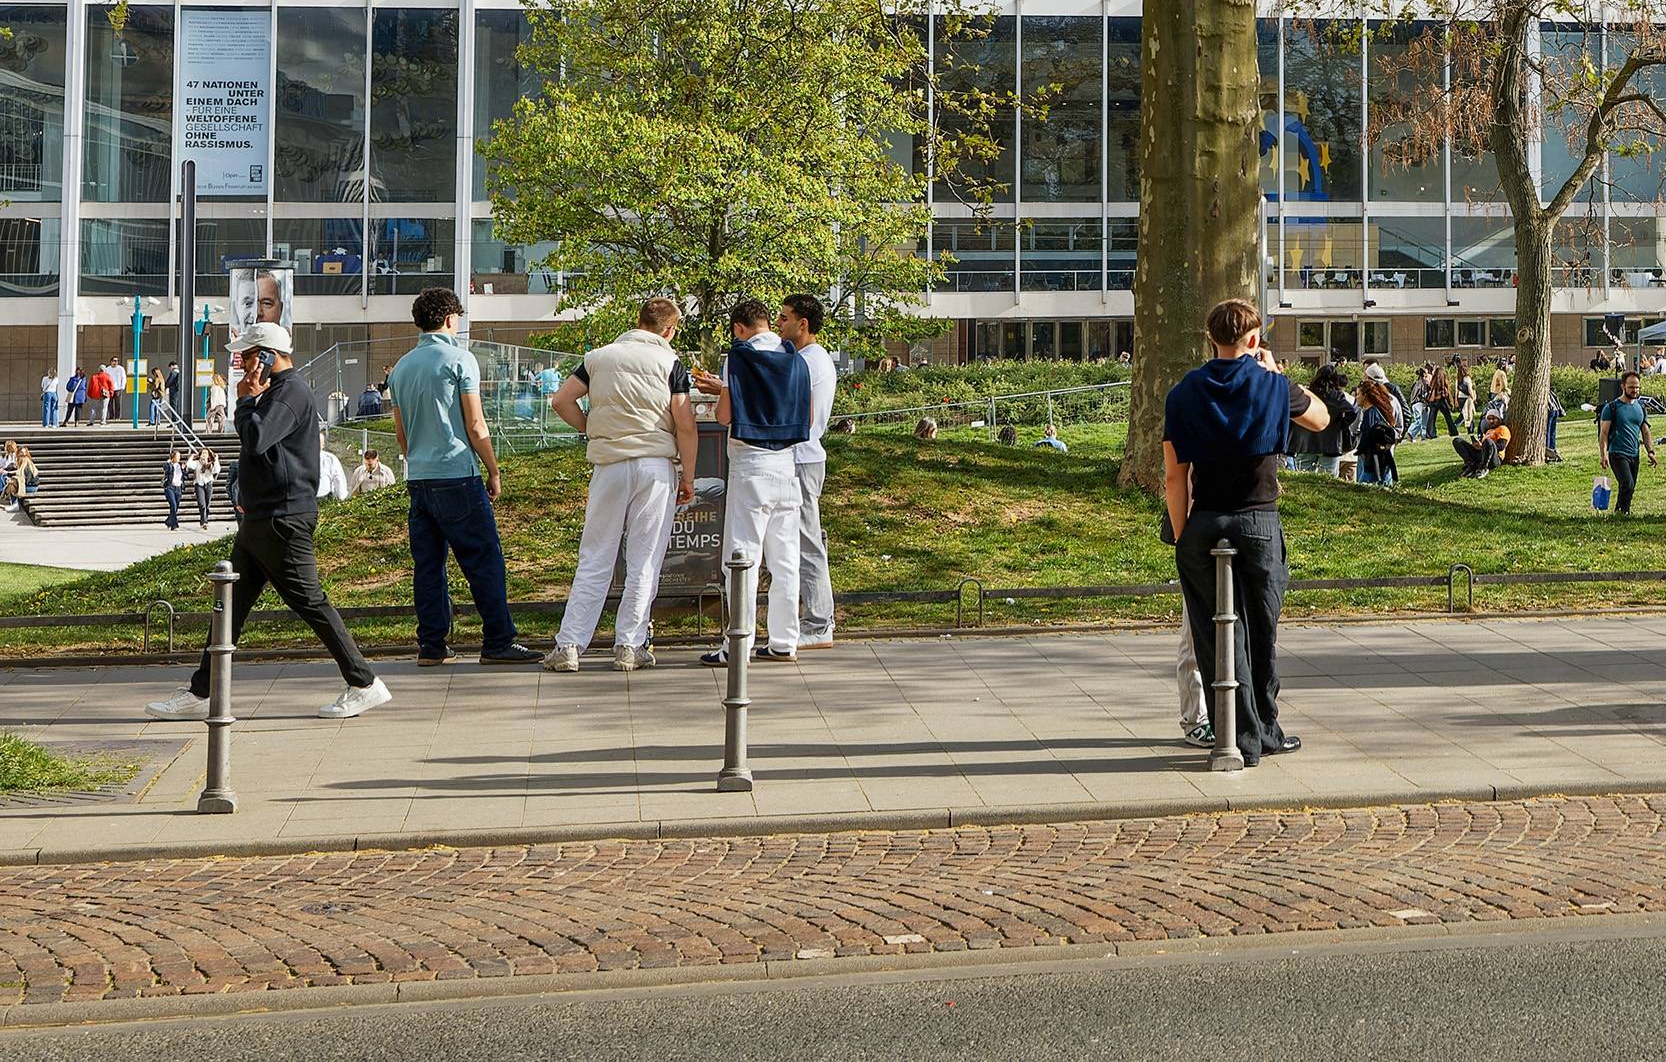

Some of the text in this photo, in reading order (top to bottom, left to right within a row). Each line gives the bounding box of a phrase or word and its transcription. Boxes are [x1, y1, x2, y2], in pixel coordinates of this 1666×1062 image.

[202, 81, 258, 89] NATIONEN
[227, 98, 258, 106] DACH
[192, 105, 212, 114] FÜR
[215, 106, 237, 114] EINE
[185, 123, 263, 131] GESELLSCHAFT
[185, 140, 253, 148] RASSISMUS.
[673, 520, 694, 534] DU
[669, 534, 720, 549] TEMPS
